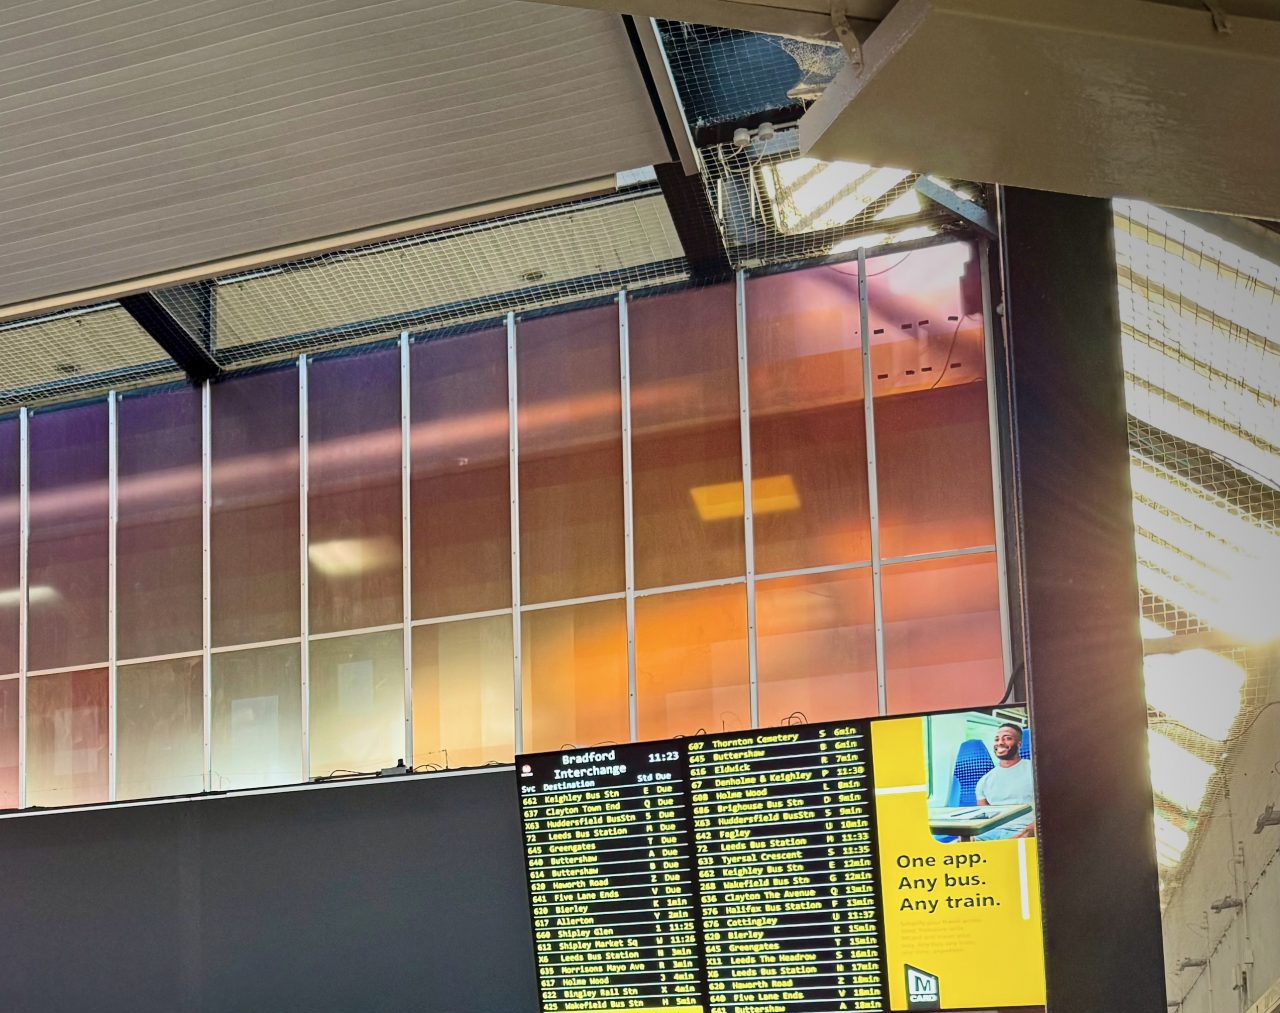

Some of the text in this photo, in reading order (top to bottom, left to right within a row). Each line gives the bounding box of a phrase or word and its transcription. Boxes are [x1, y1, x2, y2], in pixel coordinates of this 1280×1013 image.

[712, 738, 753, 748] Thornton
[834, 727, 856, 736] 6min
[562, 750, 679, 764] Bradford 11:23
[554, 764, 627, 780] Interchange
[714, 763, 750, 774] Eldwick
[543, 780, 595, 792] Destination
[637, 774, 653, 782] Std
[691, 781, 702, 789] 67
[770, 772, 812, 782] Keighley
[522, 797, 537, 806] 662
[545, 794, 583, 804] Keighley
[586, 792, 601, 800] Bus
[605, 790, 620, 798] Stn
[523, 810, 538, 818] 637
[546, 807, 579, 816] Clayton
[583, 805, 602, 813] Town
[606, 802, 621, 811] End
[525, 811, 675, 830] X63 Huddersfield BusStn Due
[548, 832, 572, 841] Leeds
[594, 828, 628, 837] Station
[527, 836, 677, 855] 645 Greengates Due
[551, 855, 598, 865] Buttershaw
[662, 849, 678, 857] Due
[896, 853, 987, 868] One app.
[530, 871, 544, 879] 614
[552, 868, 599, 877] Buttershaw
[553, 880, 587, 889] Haworth
[590, 879, 610, 887] Road
[665, 874, 680, 882] Due
[898, 873, 986, 892] Any bus.
[532, 895, 547, 903] 641
[555, 894, 574, 902] Five
[600, 891, 620, 899] Ends
[900, 893, 1001, 914] Any train.
[556, 905, 589, 914] Bierley
[667, 899, 687, 907] 1min
[557, 917, 595, 926] Allerton
[668, 911, 689, 919] 2min
[558, 930, 592, 939] Shipley
[595, 928, 614, 936] Glen
[669, 923, 694, 931] 11:25
[560, 942, 593, 951] Shipley
[596, 940, 625, 948] Market
[628, 939, 639, 947] Sq
[670, 935, 696, 944] 11:26
[561, 954, 585, 962] Leeds
[606, 951, 640, 960] Station
[672, 948, 692, 956] 3min
[731, 956, 756, 965] Leeds
[562, 966, 604, 974] Morrisons
[631, 963, 646, 971] Ave
[590, 977, 610, 985] Wood
[674, 973, 694, 981] 4min
[914, 976, 931, 991] M
[564, 990, 598, 999] Bingley
[675, 985, 695, 993] 4min
[566, 1001, 608, 1010] Wakefield
